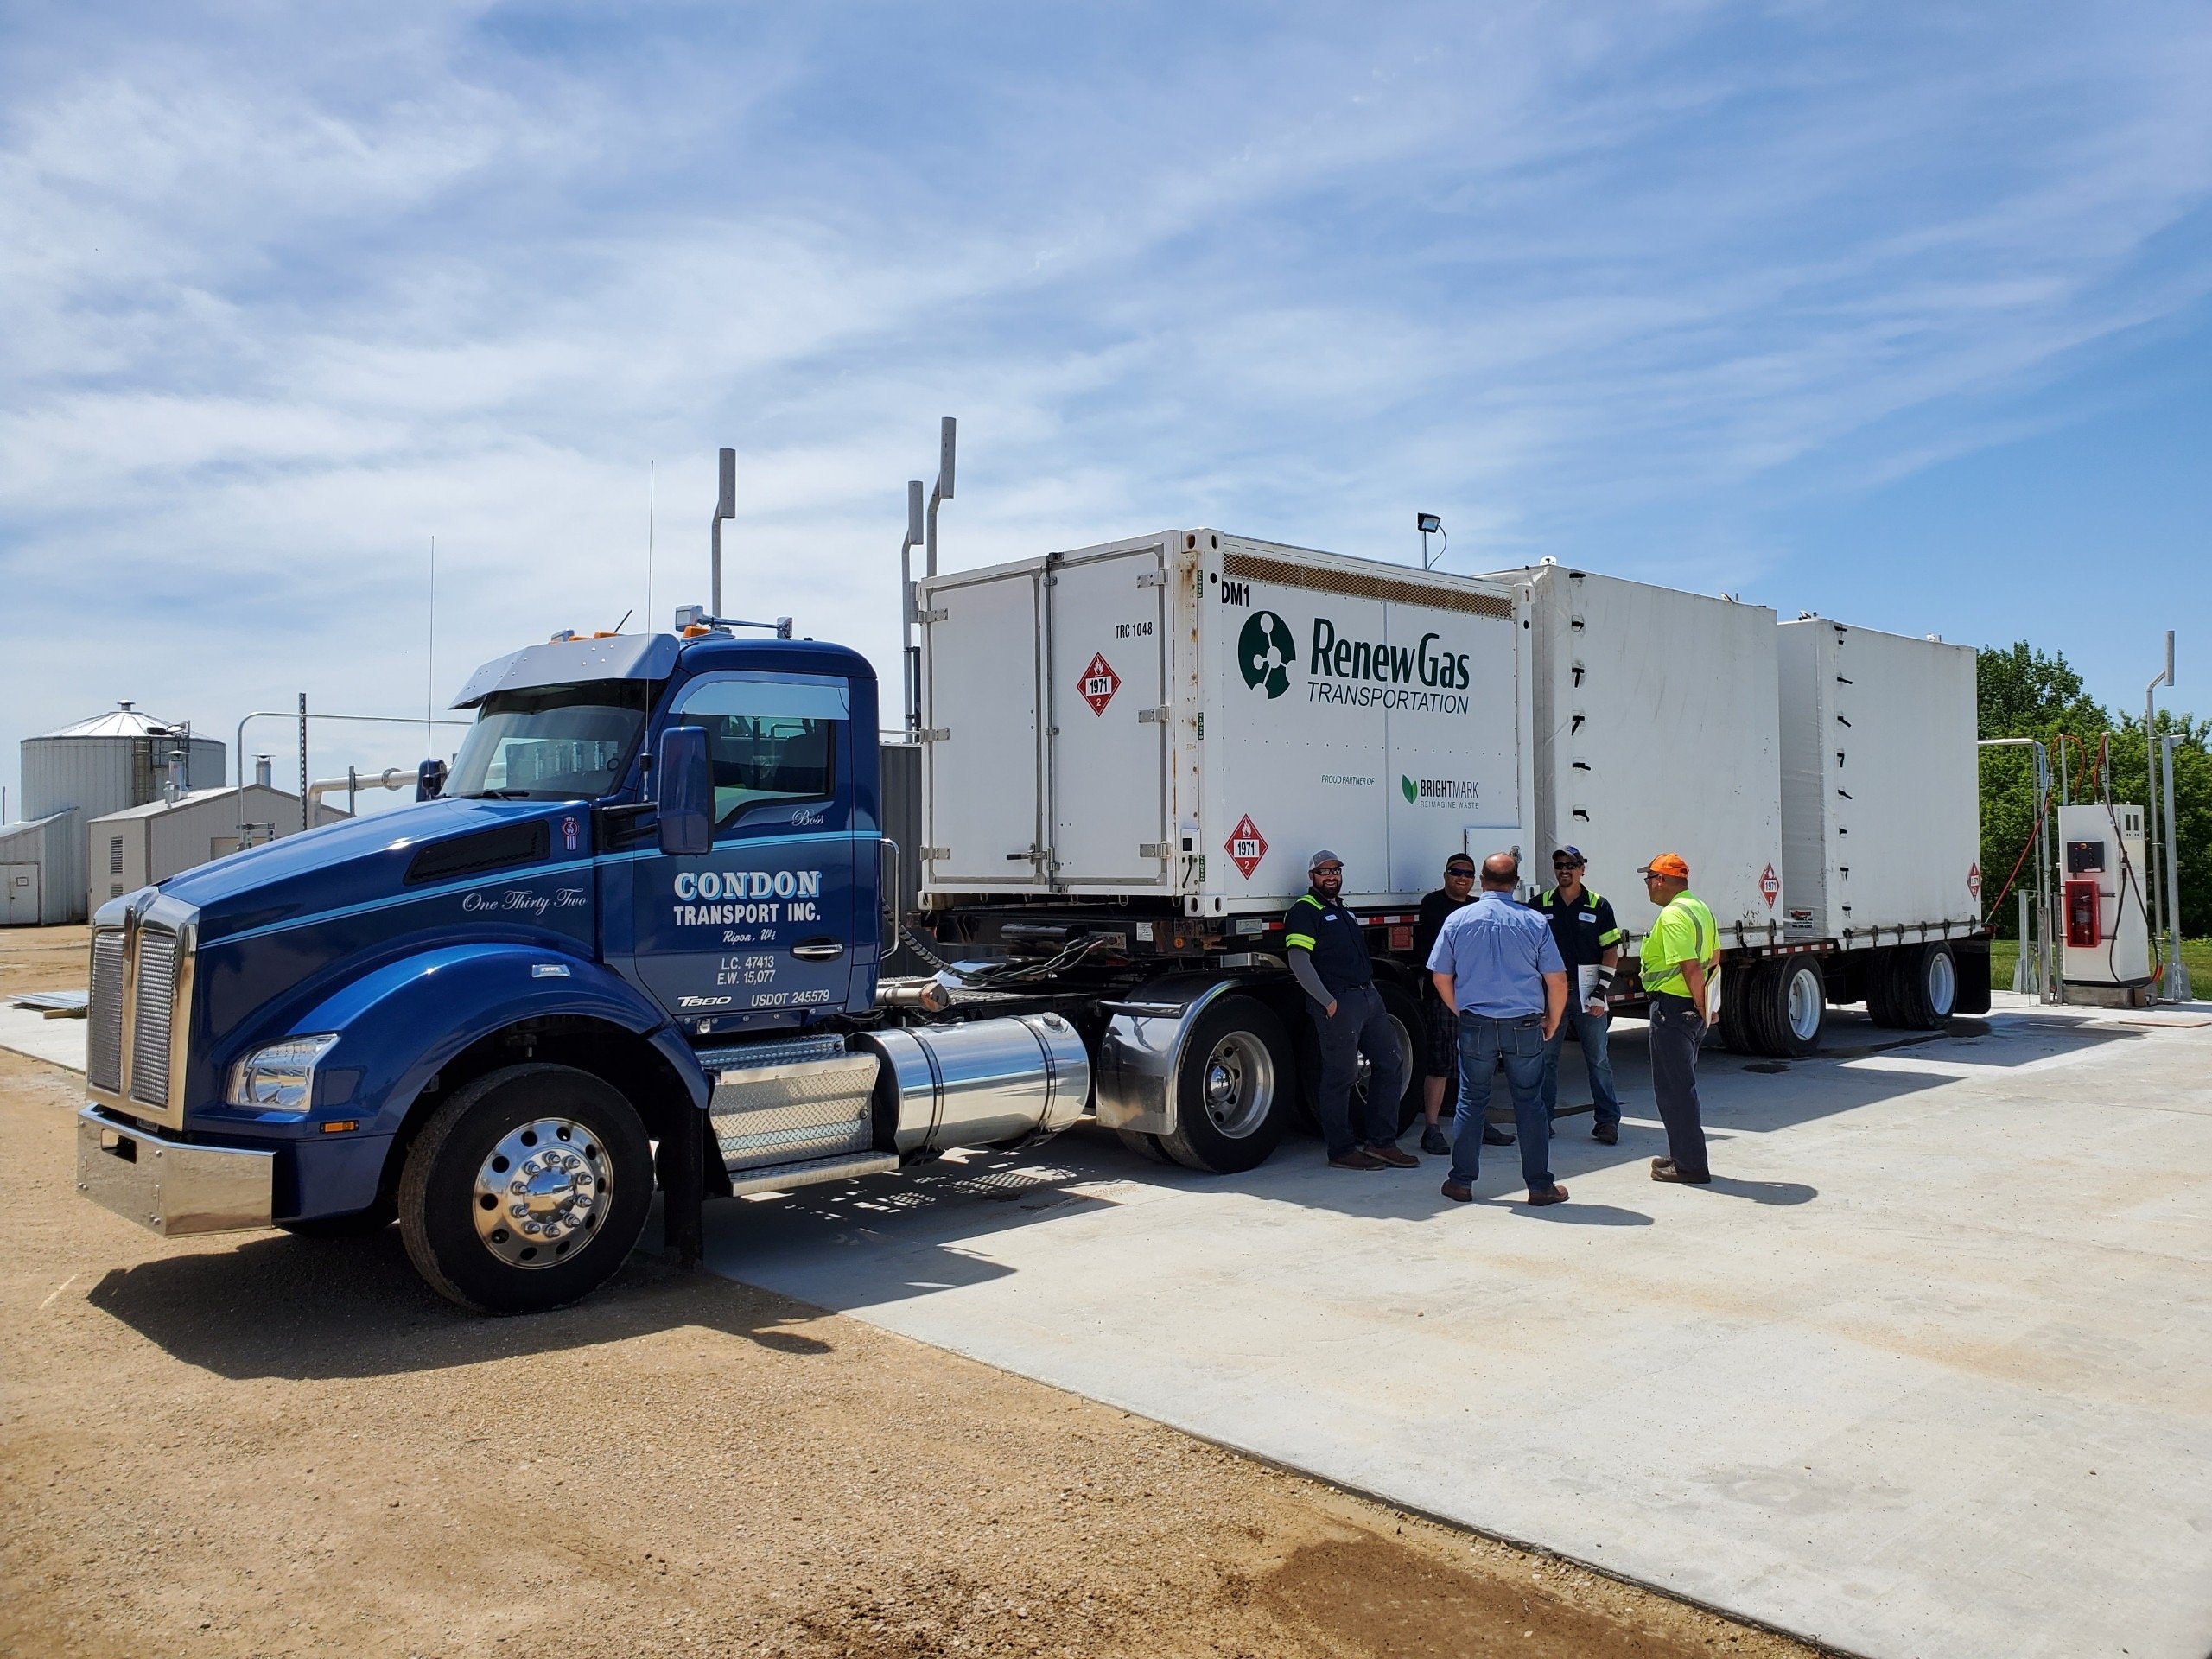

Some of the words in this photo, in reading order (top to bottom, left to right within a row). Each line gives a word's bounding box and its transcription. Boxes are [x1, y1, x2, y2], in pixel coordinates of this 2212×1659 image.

[1221, 580, 1250, 607] DM1
[1115, 624, 1130, 639] TRC
[1132, 621, 1153, 637] 1048
[1090, 678, 1108, 694] 1971
[1096, 698, 1102, 707] 2
[1307, 681, 1469, 715] TRANSPORTATION
[1321, 774, 1341, 785] PROUD
[1342, 776, 1366, 785] PARTNER
[1366, 777, 1375, 786] OF
[1420, 779, 1478, 798] BRIGHTMARK
[1421, 800, 1456, 809] REIMAGINE
[1458, 801, 1478, 810] WASTE
[791, 809, 824, 827] Boss
[1237, 841, 1255, 856] 1971
[1244, 861, 1249, 870] 2
[674, 870, 822, 901] CONDON
[1765, 881, 1777, 891] 1971
[462, 892, 499, 912] One
[501, 890, 551, 916] Thirty
[553, 888, 587, 908] Two
[1769, 896, 1773, 905] 2
[673, 904, 779, 926] TRANSPORT
[787, 902, 821, 922] INC.
[722, 930, 756, 945] Ripon,
[760, 929, 777, 941] Wi
[721, 957, 741, 970] L.C.
[745, 955, 775, 969] 47413
[717, 972, 740, 985] E.W.
[743, 969, 776, 985] 15,077
[677, 996, 733, 1007] T880
[751, 993, 789, 1007] USDOT
[791, 989, 830, 1004] 245579
